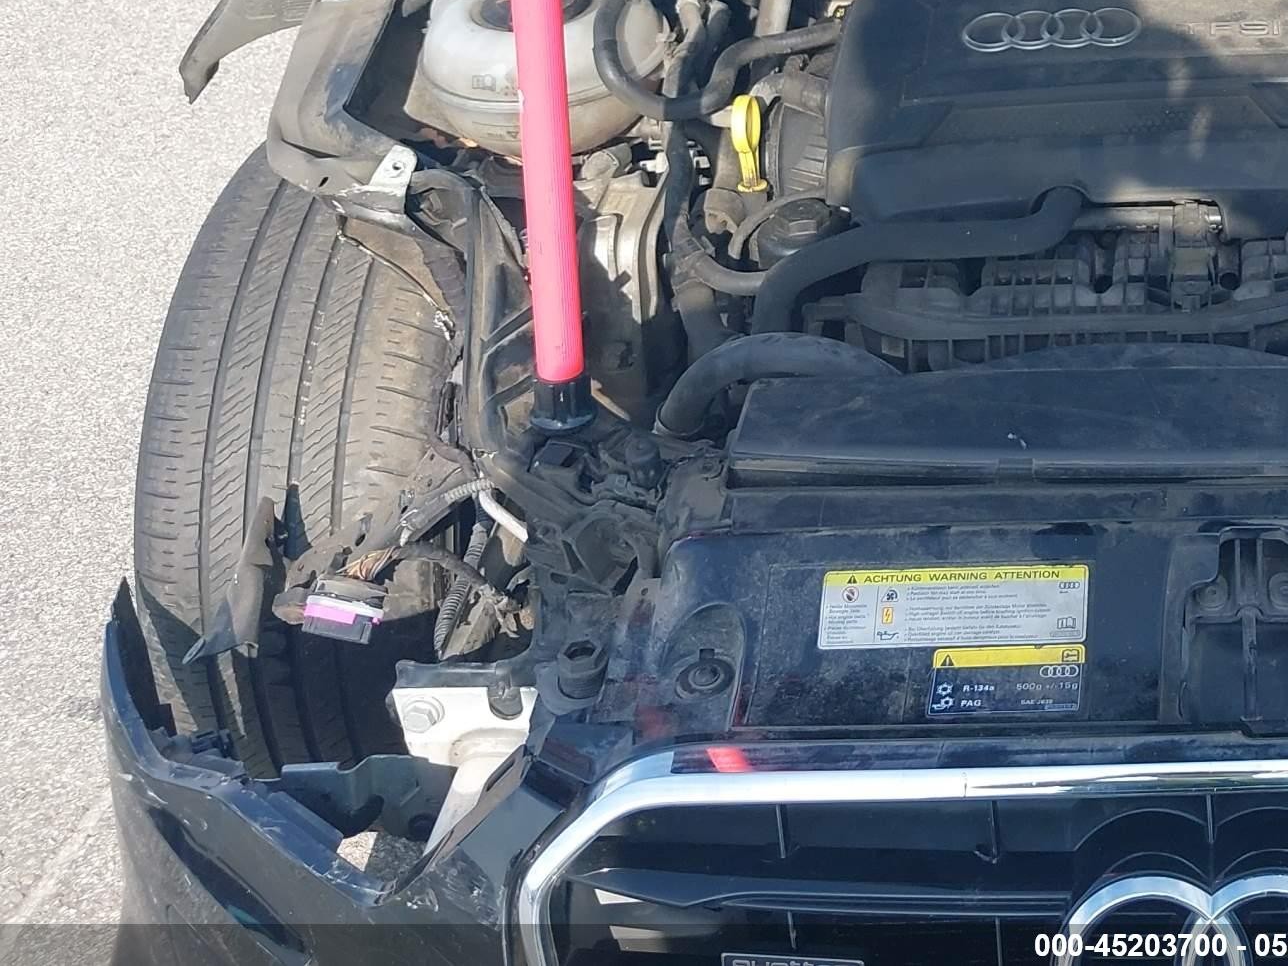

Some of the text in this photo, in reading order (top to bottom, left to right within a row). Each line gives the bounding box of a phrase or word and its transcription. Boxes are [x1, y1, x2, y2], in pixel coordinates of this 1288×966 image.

[1175, 20, 1281, 37] TFSI
[864, 569, 1061, 584] ACHTUNG WARNING ATTENTION
[963, 684, 995, 693] R-134a
[960, 699, 982, 707] PAG
